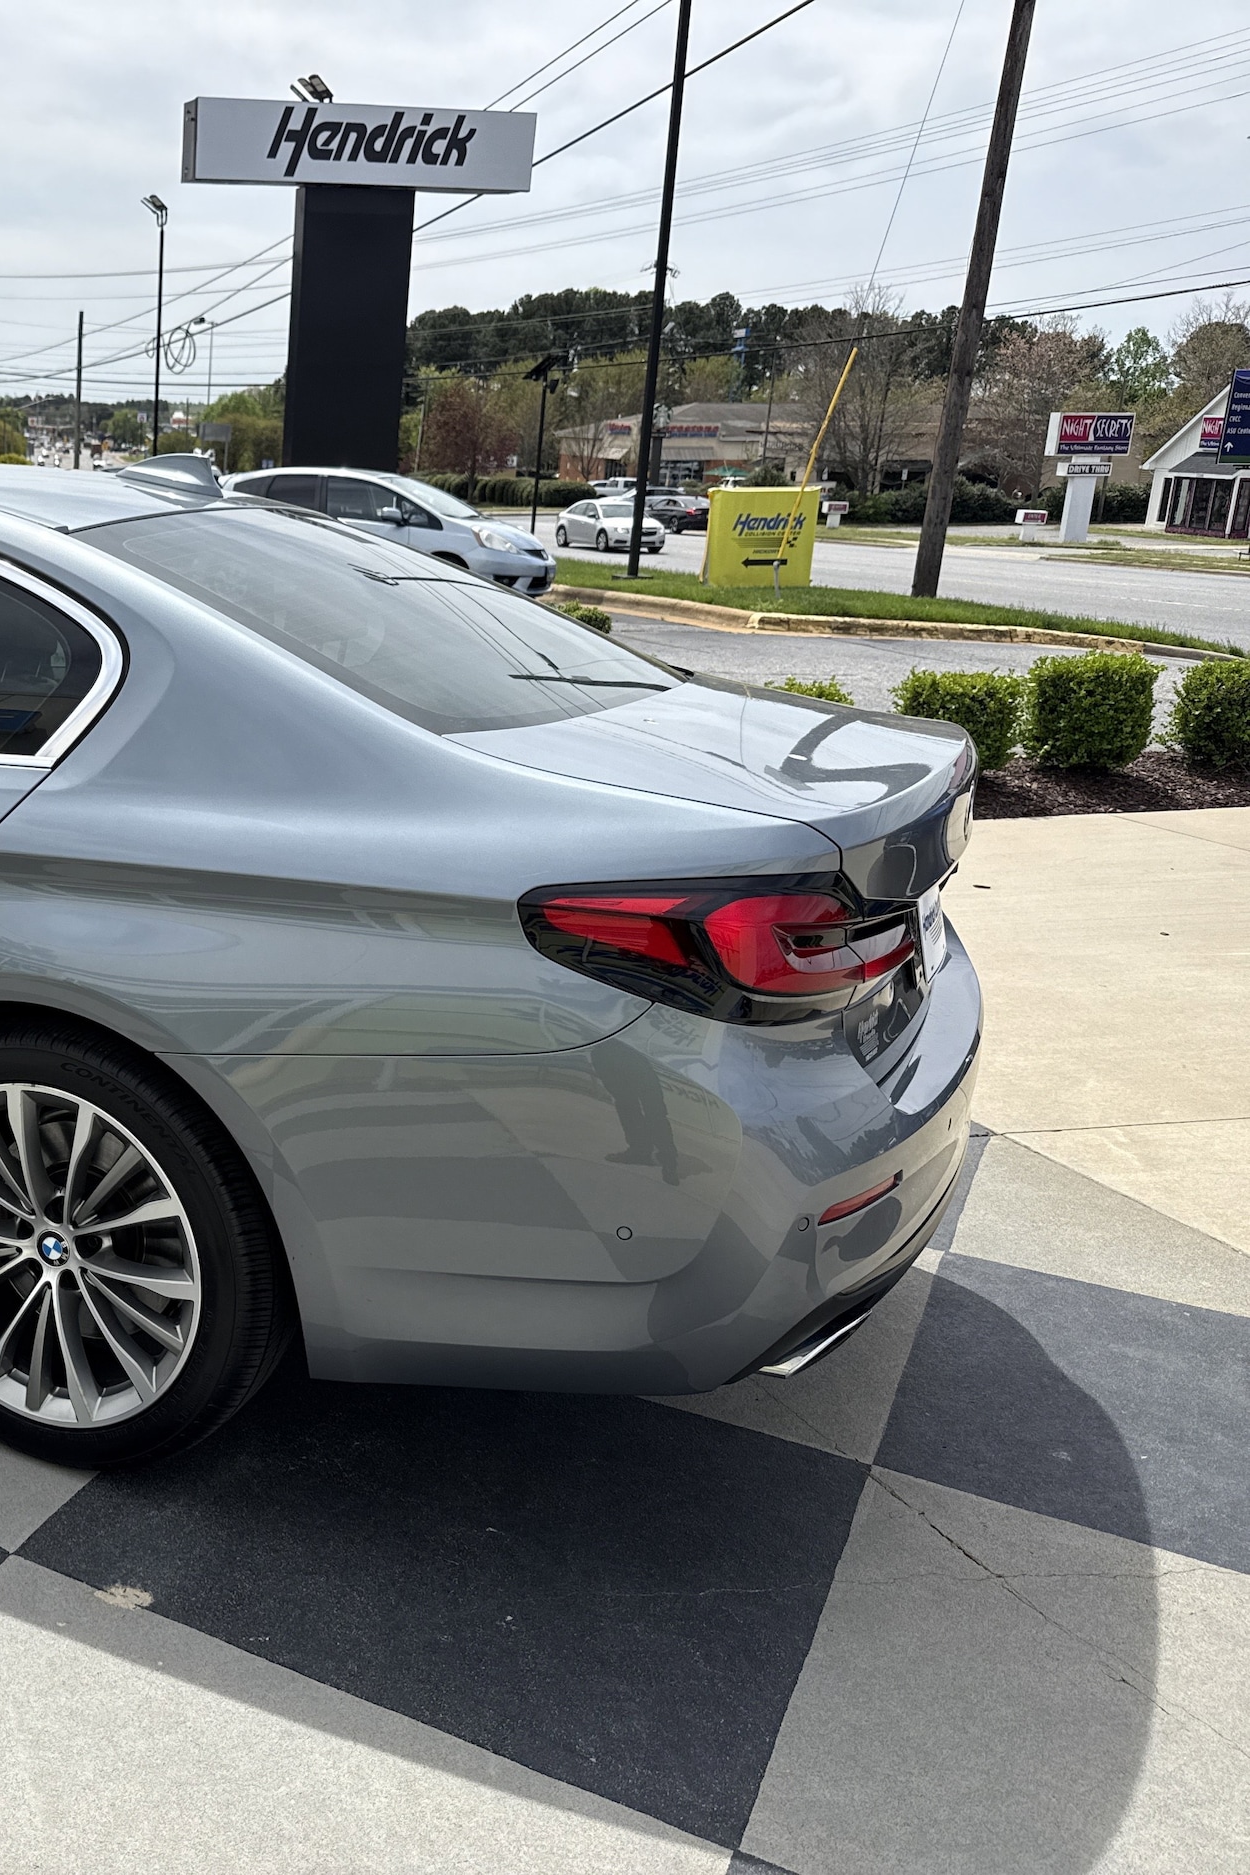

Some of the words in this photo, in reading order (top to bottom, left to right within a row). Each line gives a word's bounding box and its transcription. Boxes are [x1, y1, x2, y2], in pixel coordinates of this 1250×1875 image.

[267, 106, 477, 177] Hendrick
[1095, 418, 1132, 438] SECRETS
[1068, 465, 1090, 474] DRIVE
[1091, 465, 1110, 474] THRU
[60, 1062, 197, 1177] CONTINENTAL
